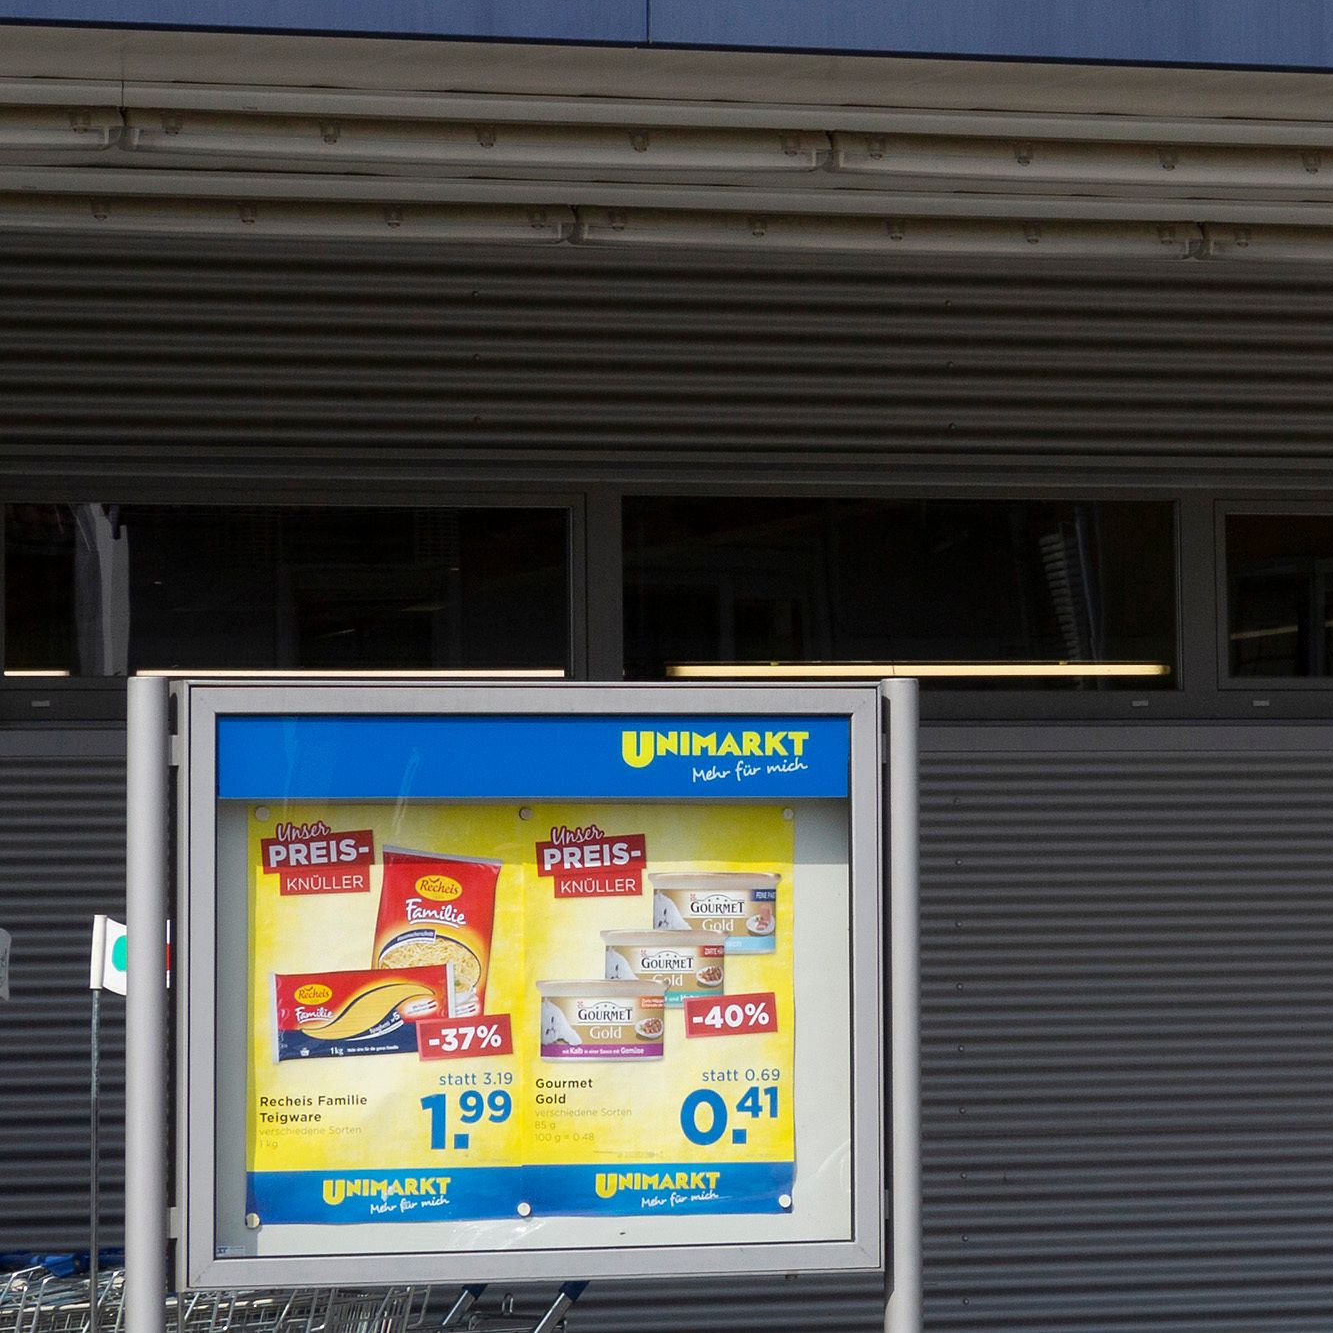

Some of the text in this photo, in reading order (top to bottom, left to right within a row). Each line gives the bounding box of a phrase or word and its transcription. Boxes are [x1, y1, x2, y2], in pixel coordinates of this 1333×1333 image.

[621, 730, 810, 769] UNIMARKT
[692, 757, 809, 783] Mehr für mich
[277, 821, 331, 843] Unser
[551, 824, 604, 846] Unser
[268, 838, 370, 868] PREIS-
[543, 842, 642, 872] PREIS-
[287, 874, 365, 892] KNÜLLER
[419, 877, 460, 896] Recheis
[560, 877, 636, 894] KNÜLLER
[405, 897, 467, 925] Familie
[690, 900, 745, 914] GOURMET
[702, 918, 734, 932] Gold
[641, 956, 695, 970] GOURMET
[298, 987, 331, 1000] Recheis
[295, 1006, 334, 1022] Familie
[578, 1007, 633, 1022] GOURMET
[692, 1002, 770, 1029] -40%
[428, 1024, 502, 1052] -37%
[589, 1026, 622, 1039] Gold
[439, 1072, 513, 1086] statt 3.19
[535, 1078, 593, 1089] Gourmet
[702, 1068, 780, 1081] statt 0.69
[260, 1094, 368, 1107] Recheis Familie
[535, 1094, 567, 1105] Gold
[260, 1112, 322, 1125] Teigware
[420, 1090, 513, 1150] 1.99
[535, 1108, 633, 1117] verschiedene Sorten
[680, 1086, 779, 1146] 0.41
[259, 1125, 362, 1136] verschiedene Sorten
[322, 1177, 452, 1206] UNIMARKT
[595, 1172, 721, 1199] UNIMARKT
[370, 1203, 397, 1214] Mehr
[421, 1195, 450, 1207] mich
[641, 1189, 720, 1208] Mehr für mich
